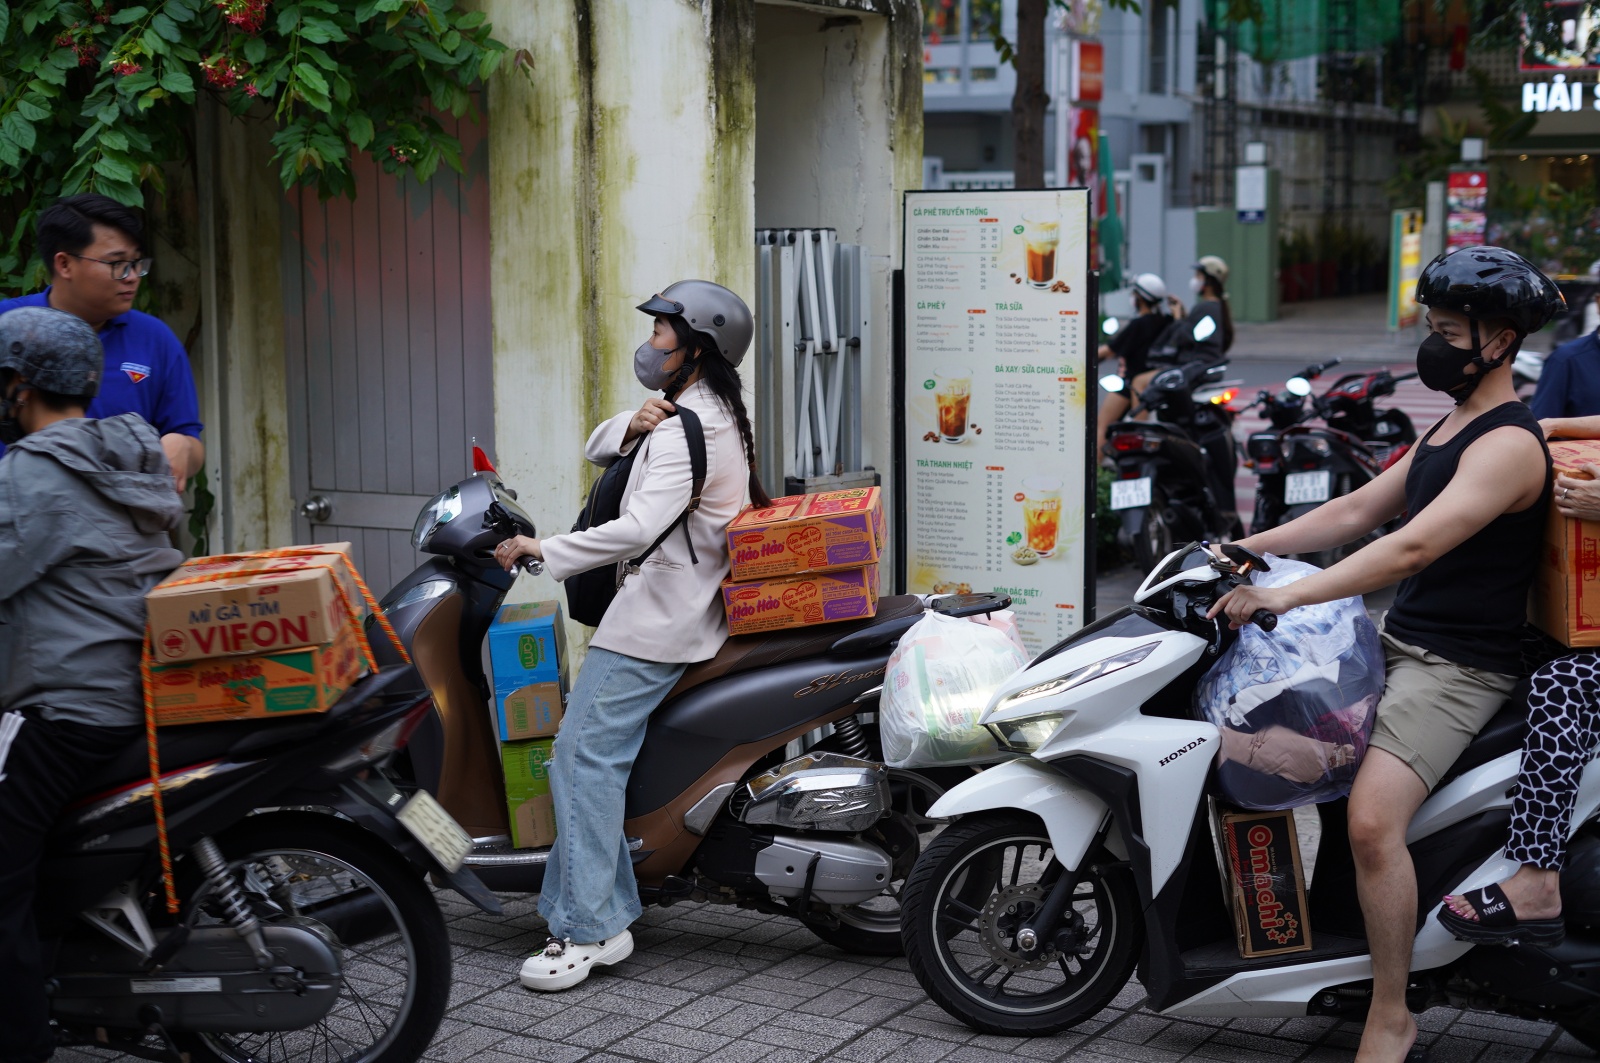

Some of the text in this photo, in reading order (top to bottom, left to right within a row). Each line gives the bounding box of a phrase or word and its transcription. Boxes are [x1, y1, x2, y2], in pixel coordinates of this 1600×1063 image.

[1522, 73, 1582, 112] HẢI
[913, 207, 922, 216] CÀ
[924, 207, 937, 216] PHÊ
[917, 301, 926, 309] CÀ
[927, 300, 940, 309] PHÊ
[995, 301, 1023, 310] TRÀ SỮA
[995, 364, 1004, 373] ĐÁ
[1022, 364, 1035, 374] SỮA
[1037, 366, 1055, 374] CHUA
[1060, 364, 1073, 374] SỮA
[916, 458, 973, 471] TRÀ THANH NHIỆT
[736, 540, 785, 564] Hảo Hảo
[1024, 588, 1039, 598] BIỆT
[189, 603, 210, 625] MÌ
[215, 602, 242, 621] GÀ
[732, 595, 780, 619] Hảo Hảo
[188, 616, 309, 654] VIFON
[1158, 736, 1208, 767] HONDA
[1248, 825, 1285, 929] Omachi
[1482, 901, 1506, 916] NIKE
